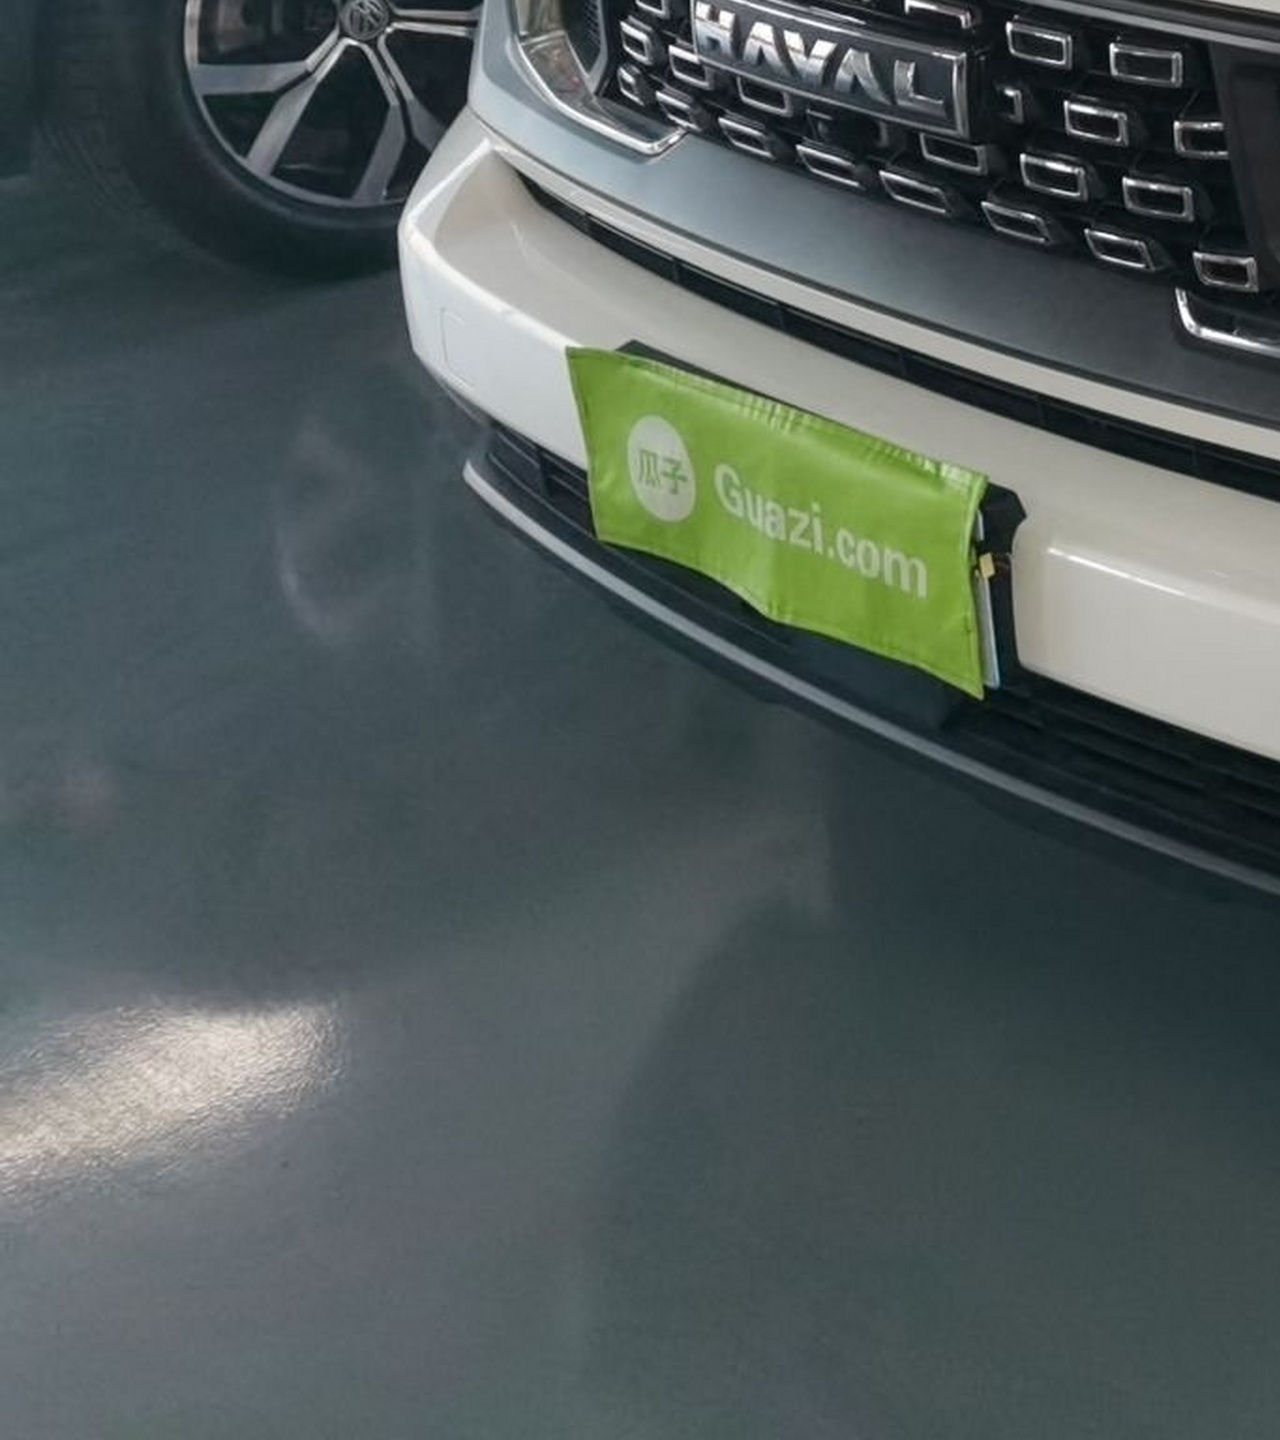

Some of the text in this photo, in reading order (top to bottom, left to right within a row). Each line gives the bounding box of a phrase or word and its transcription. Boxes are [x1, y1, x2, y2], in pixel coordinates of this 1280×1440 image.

[695, 0, 950, 121] HAVAL
[637, 448, 690, 496] 瓜子
[714, 464, 928, 599] Guazi.com
